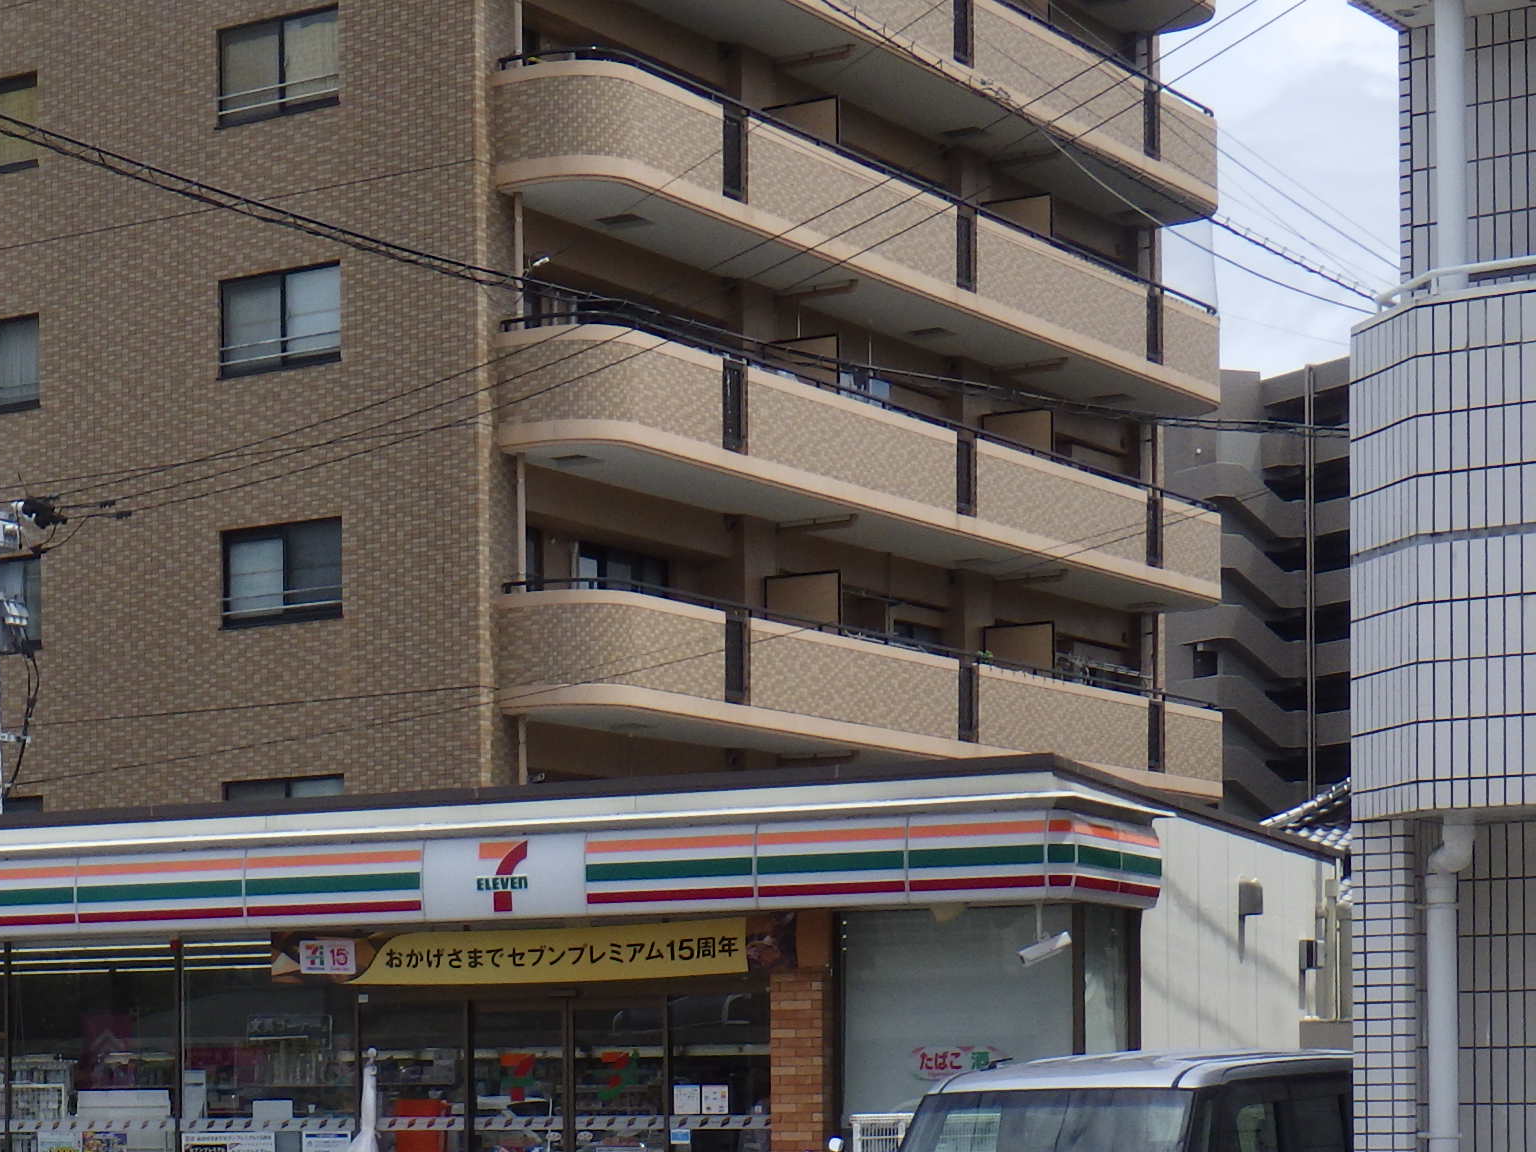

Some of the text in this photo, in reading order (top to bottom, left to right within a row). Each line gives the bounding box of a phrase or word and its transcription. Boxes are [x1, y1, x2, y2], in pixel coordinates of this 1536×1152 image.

[385, 935, 739, 969] おかげさまでセブンプレミアム15周年
[919, 1051, 962, 1070] たばこ
